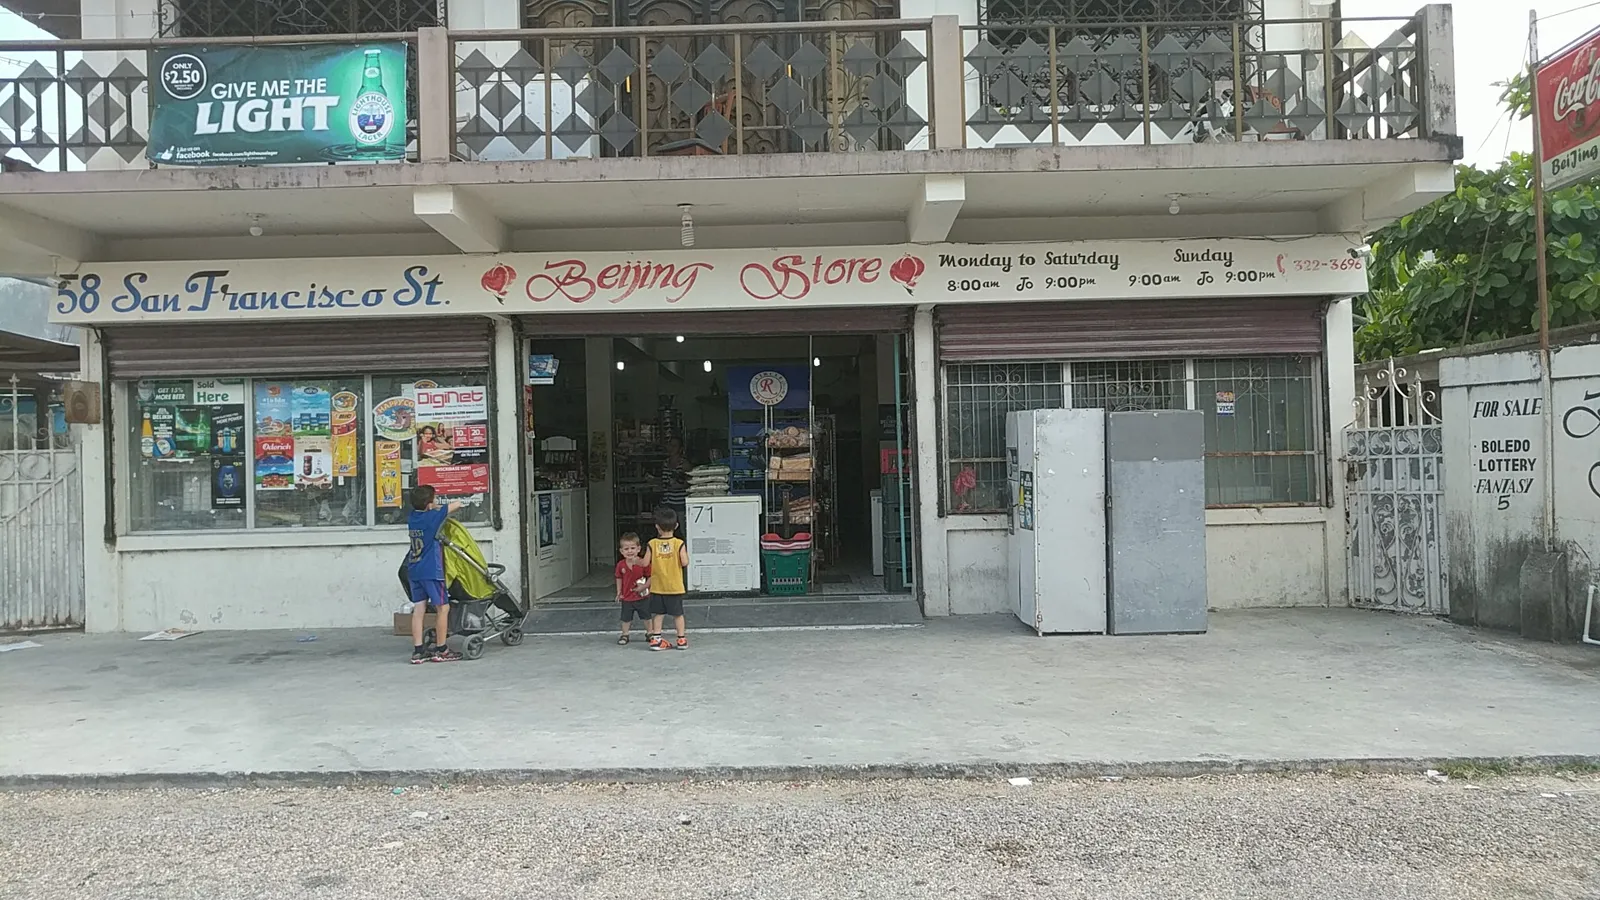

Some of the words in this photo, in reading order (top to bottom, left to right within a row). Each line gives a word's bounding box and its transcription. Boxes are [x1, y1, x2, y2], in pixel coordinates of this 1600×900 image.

[165, 70, 200, 84] $2.50
[210, 81, 256, 100] GIVE
[261, 80, 292, 96] ME
[294, 78, 327, 95] THE
[352, 95, 392, 116] LIGHTHOUSE
[194, 95, 340, 135] LIGHT
[358, 131, 383, 141] LAGER
[176, 150, 210, 159] facebook
[938, 253, 1013, 272] Monday
[1018, 253, 1036, 266] to
[1044, 252, 1120, 270] Saturday
[1173, 248, 1234, 267] Sunday
[1293, 258, 1363, 271] 322-3696
[526, 259, 714, 304] Beijing
[740, 255, 882, 300] Store
[57, 273, 101, 314] 58
[112, 272, 182, 313] San
[185, 269, 387, 312] Francisco
[393, 265, 451, 306] St.
[197, 381, 214, 389] Sold
[760, 378, 777, 395] R
[197, 391, 229, 402] Here
[417, 390, 484, 408] DigiNet
[376, 399, 404, 415] HAPPY
[404, 399, 416, 409] CO
[1472, 401, 1499, 418] FOR
[1502, 397, 1542, 417] SALE
[1481, 440, 1531, 453] BOLEDO
[1479, 458, 1537, 472] LOTTERY
[1476, 478, 1534, 494] FANTASY
[1497, 494, 1511, 510] 5
[692, 505, 714, 523] 71
